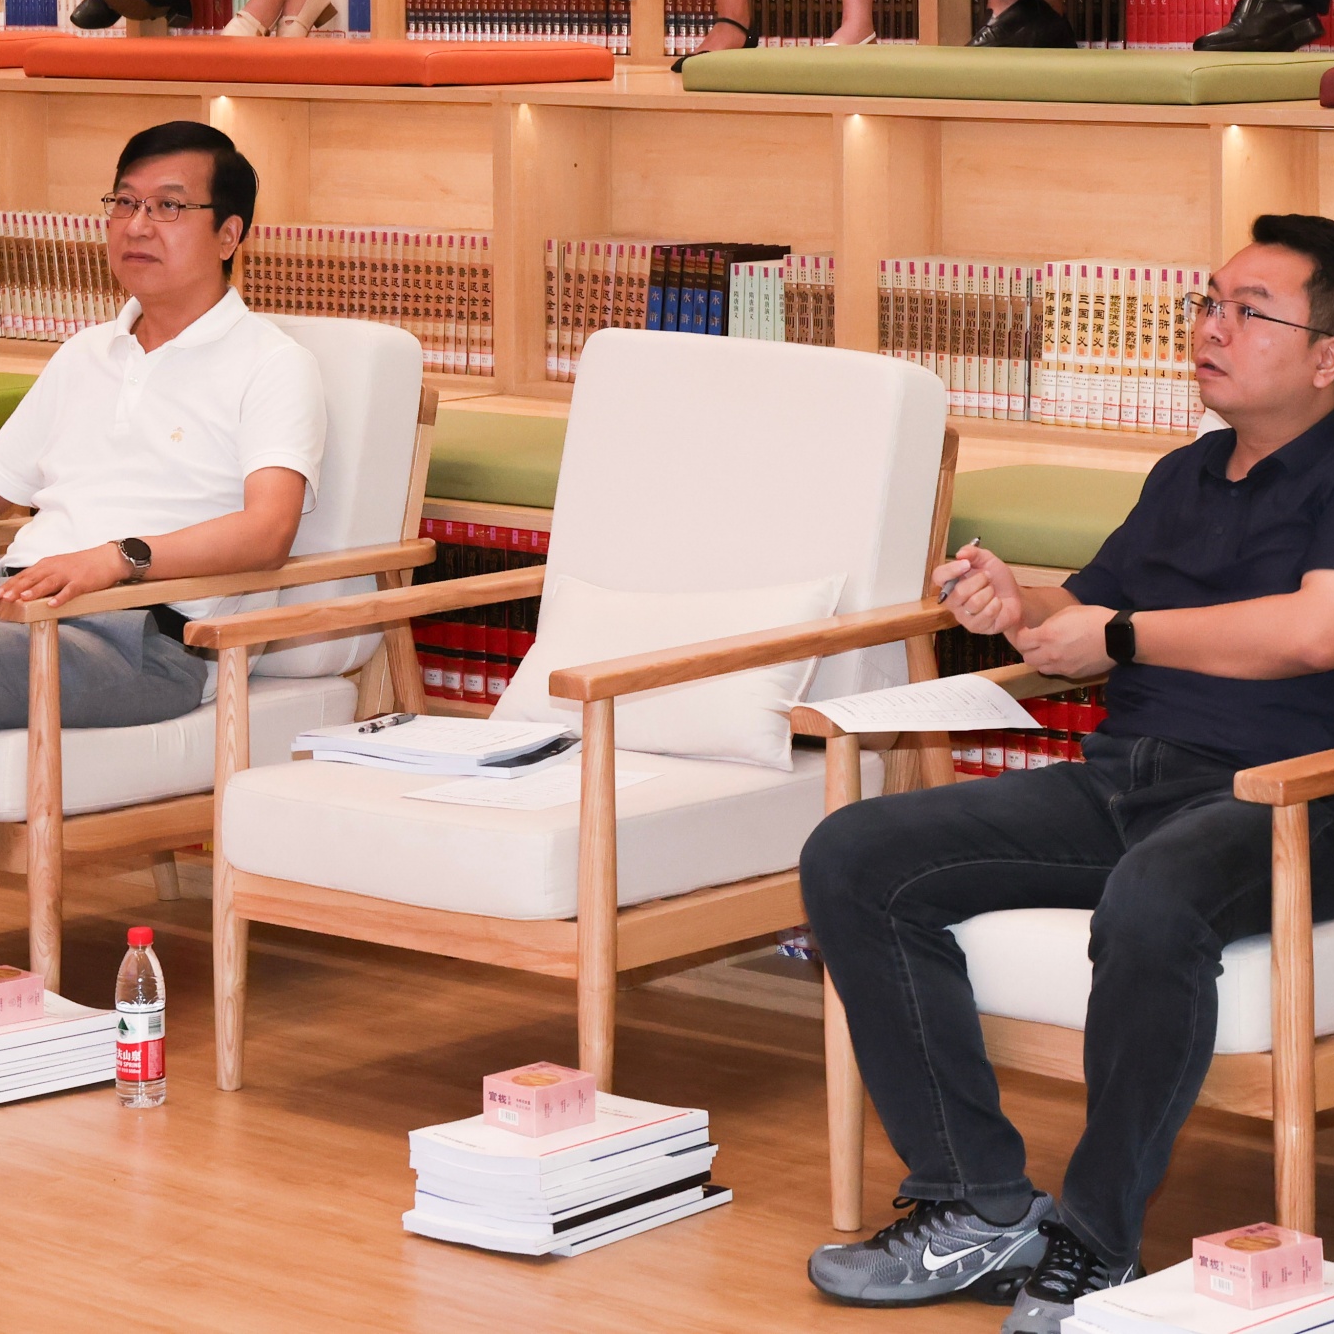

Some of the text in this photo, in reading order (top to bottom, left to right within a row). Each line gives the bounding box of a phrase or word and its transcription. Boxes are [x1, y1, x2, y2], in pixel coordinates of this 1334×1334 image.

[1046, 362, 1051, 370] 1
[1062, 363, 1066, 371] 1
[1079, 365, 1084, 373] 2
[1094, 366, 1099, 374] 2
[1110, 367, 1115, 375] 3
[1127, 369, 1132, 377] 3
[1144, 369, 1149, 377] 4
[1161, 370, 1166, 378] 4
[1177, 372, 1182, 380] 5
